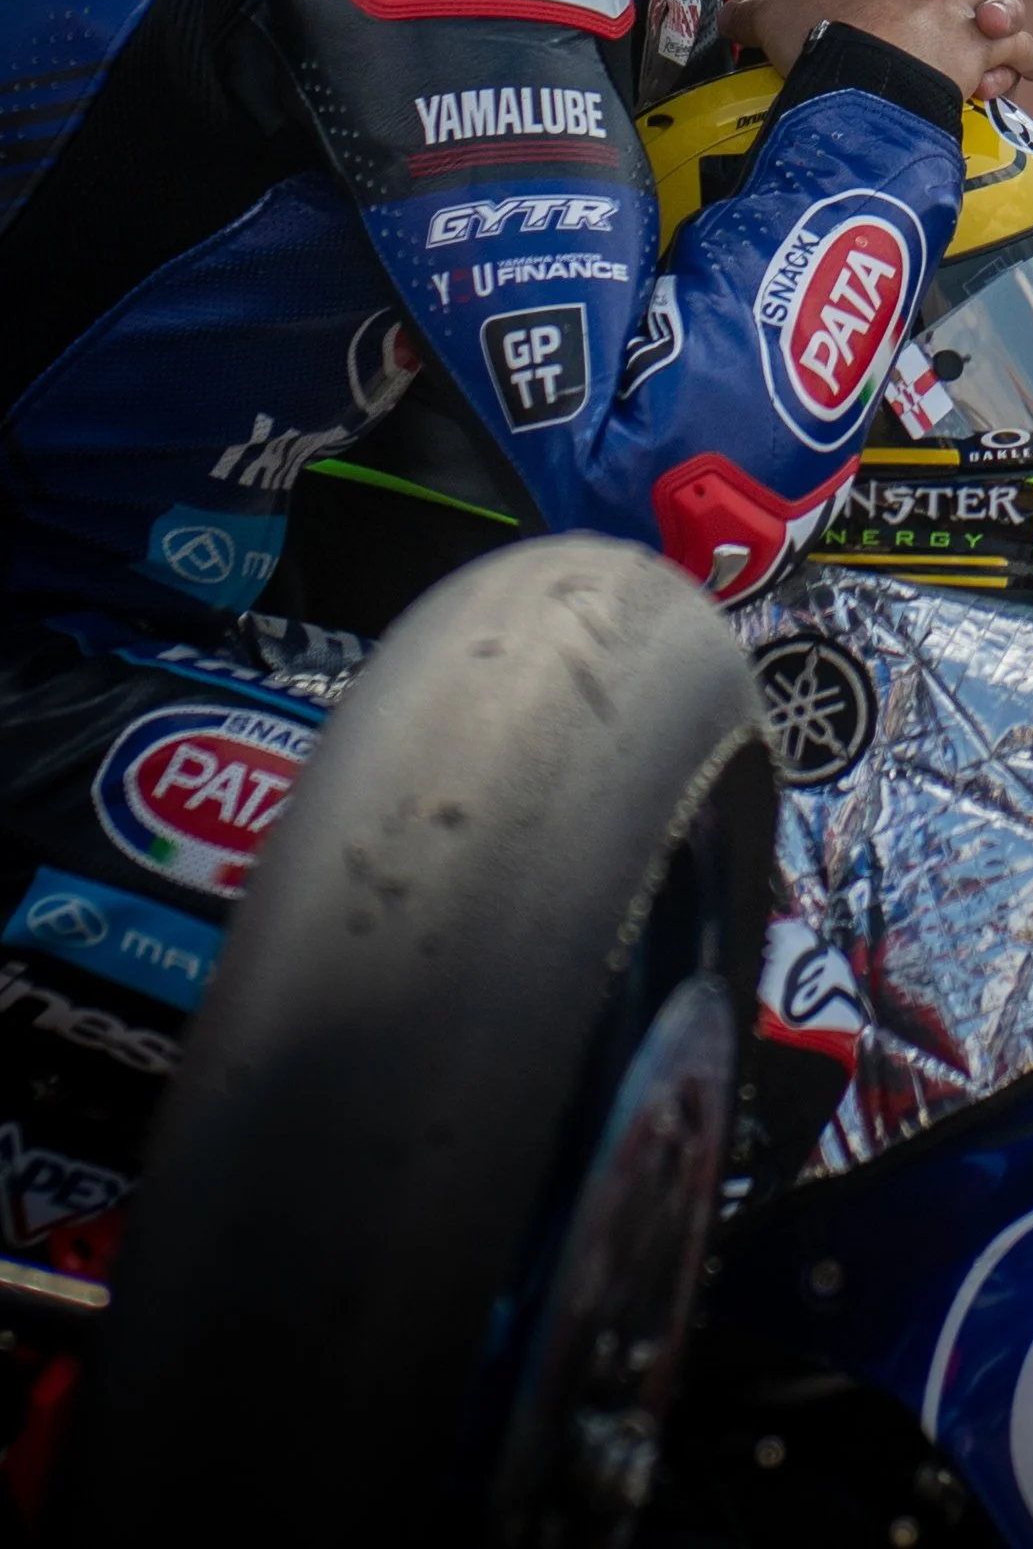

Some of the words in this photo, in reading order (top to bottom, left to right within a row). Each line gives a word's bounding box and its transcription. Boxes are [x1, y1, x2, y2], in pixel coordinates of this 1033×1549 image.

[415, 86, 607, 145] YAMALUBE
[425, 194, 619, 249] GYTR
[497, 260, 630, 287] FINANCE
[762, 233, 820, 325] SNACK
[799, 250, 897, 396] PATA
[502, 324, 562, 371] GP
[511, 364, 564, 410] TT
[842, 479, 1026, 526] NSTER
[823, 528, 984, 549] NERGY
[222, 712, 318, 758] SNAC
